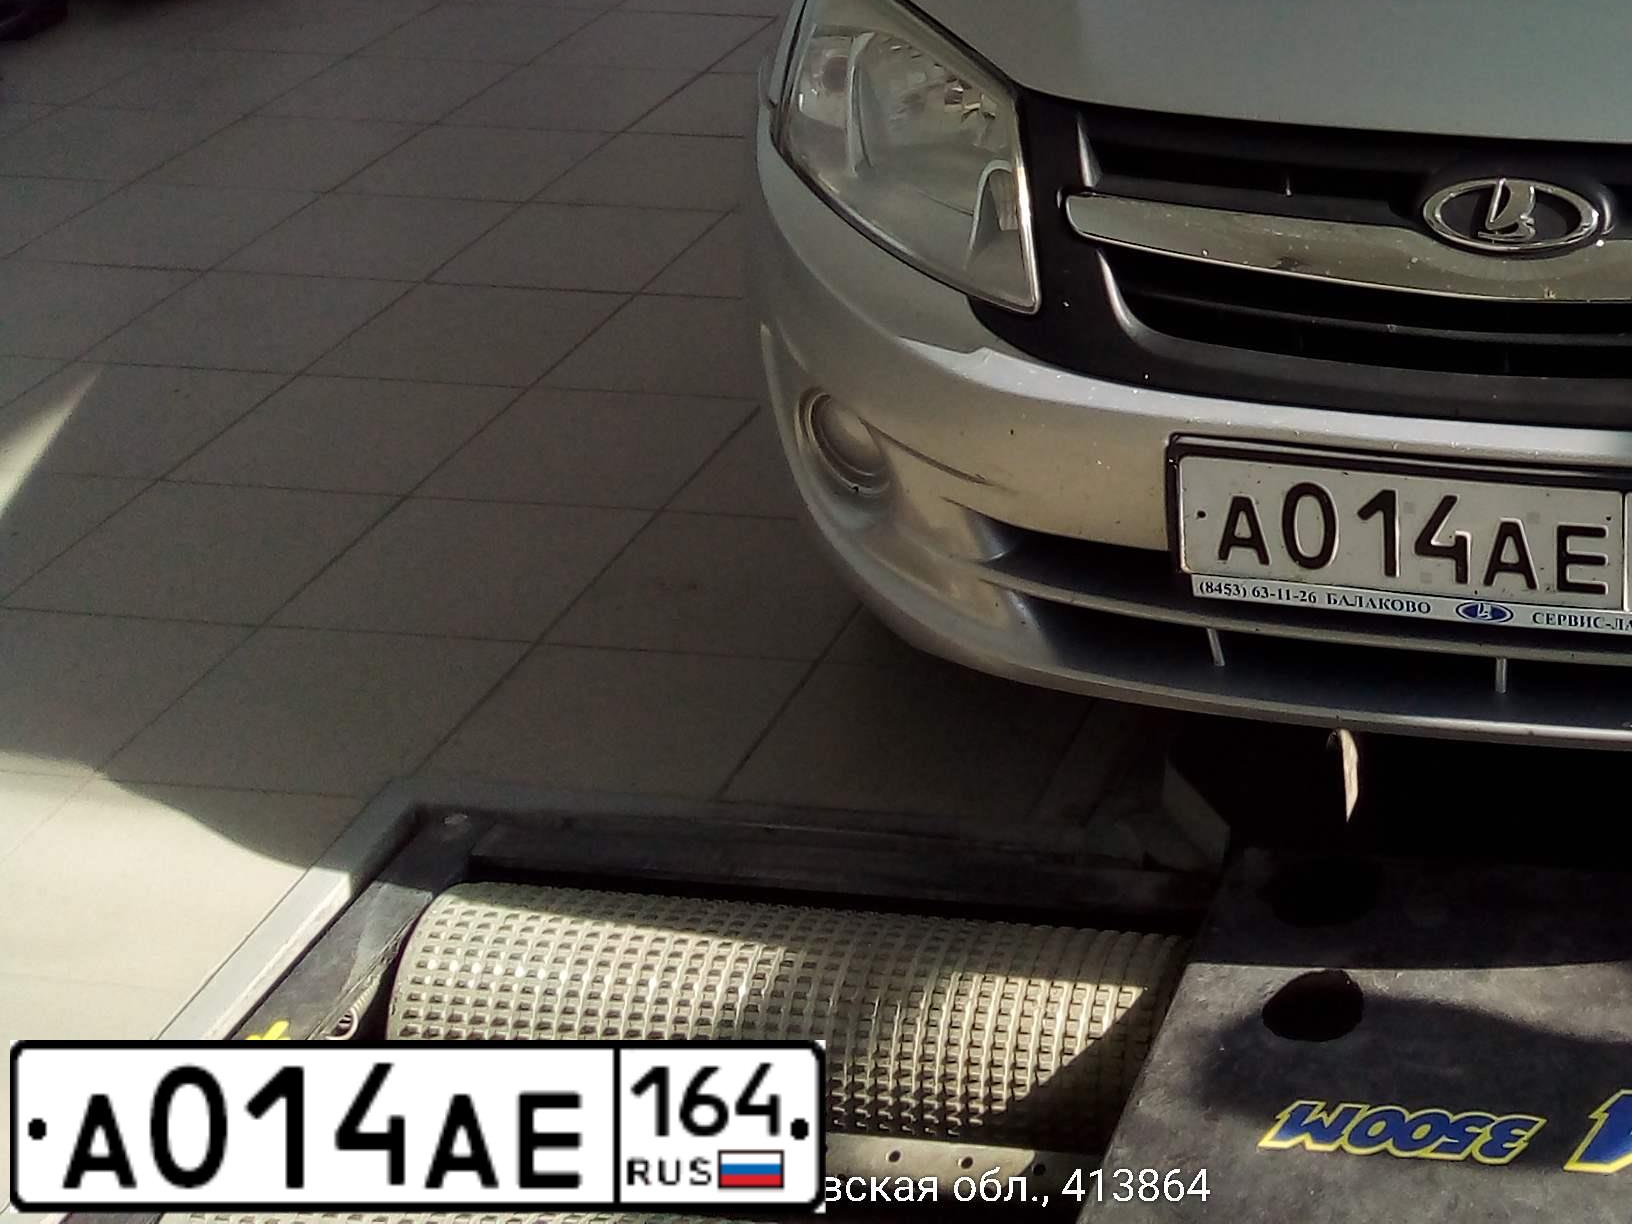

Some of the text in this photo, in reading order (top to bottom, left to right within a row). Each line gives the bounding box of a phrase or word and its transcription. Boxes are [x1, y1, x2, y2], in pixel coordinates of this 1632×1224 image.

[1217, 481, 1608, 594] А014АЕ
[1199, 581, 1248, 599] (8453)
[1251, 586, 1318, 605] 63-11-26
[1326, 592, 1432, 615] БАЛАКОВО
